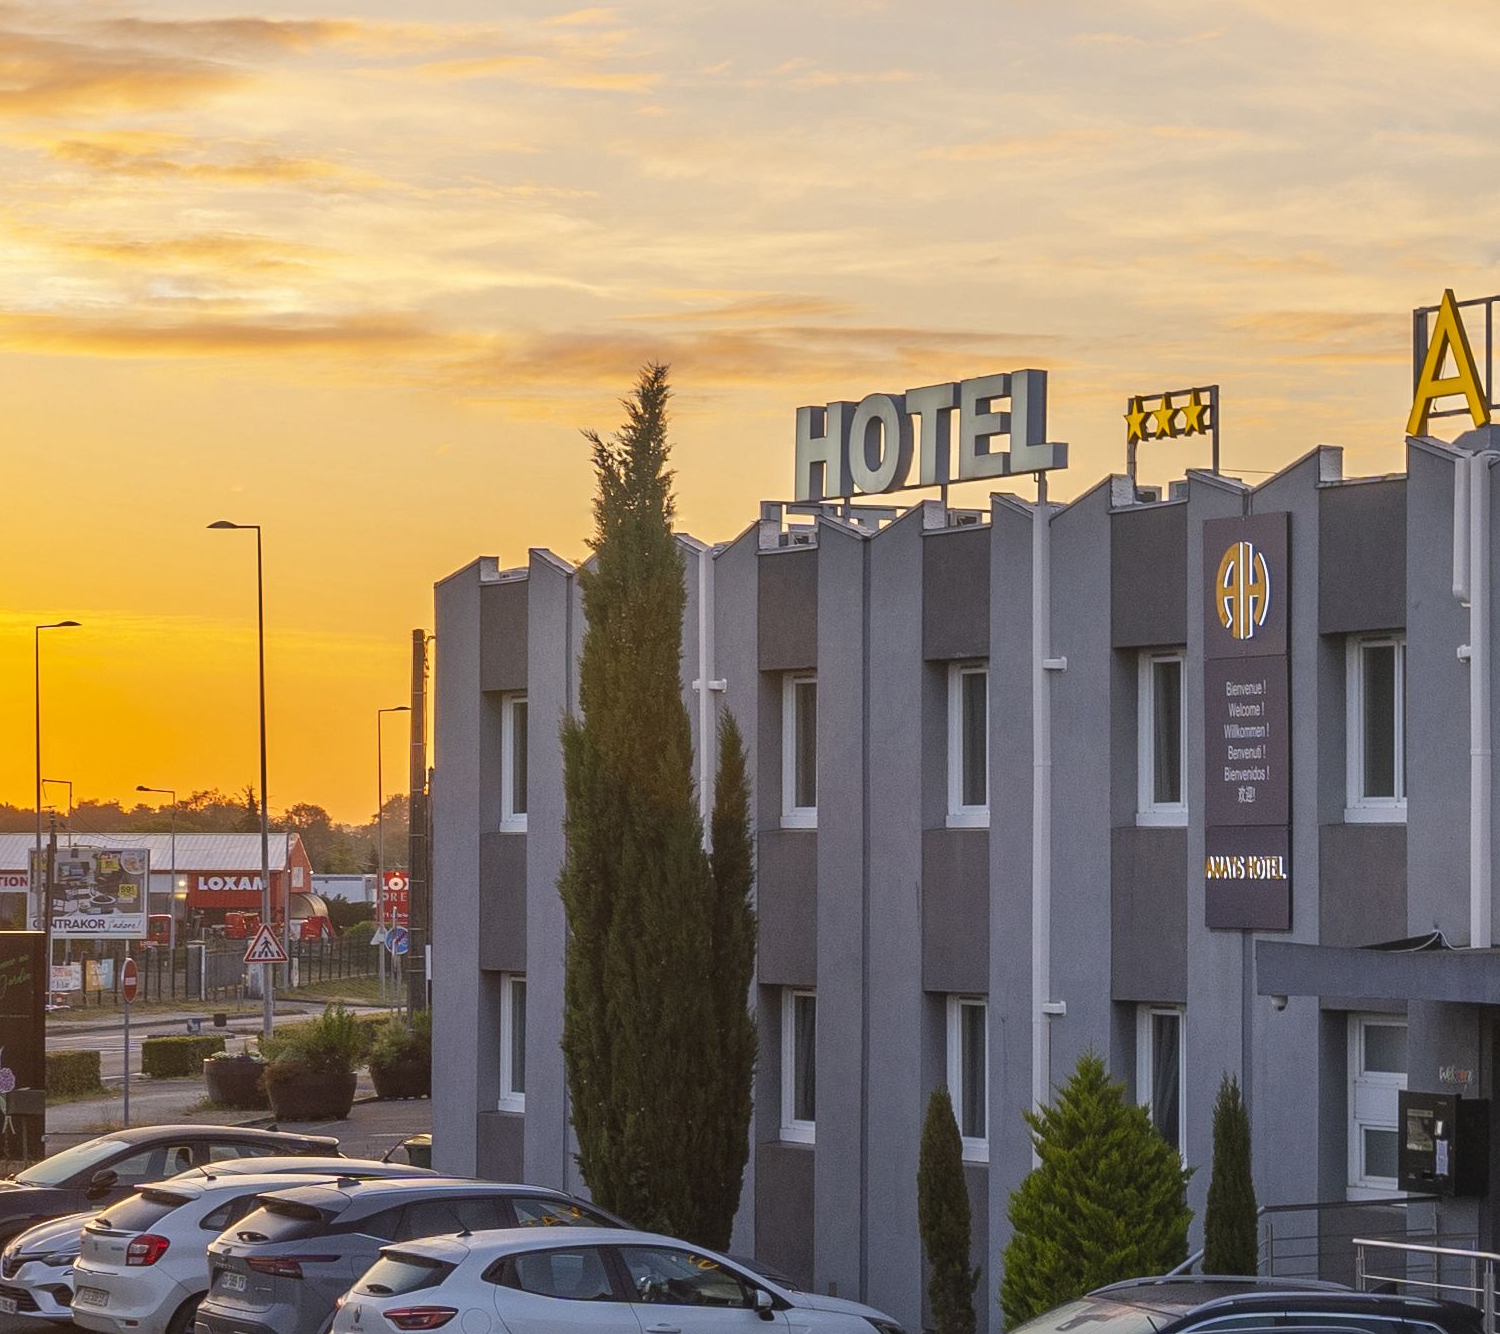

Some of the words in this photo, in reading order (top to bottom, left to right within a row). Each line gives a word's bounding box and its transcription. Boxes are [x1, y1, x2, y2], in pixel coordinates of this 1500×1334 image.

[795, 368, 1068, 501] HOTEL
[1225, 681, 1262, 697] Bienvenue
[1228, 702, 1260, 717] Welcome
[1223, 723, 1265, 739] Willkommen
[1227, 745, 1262, 760] Benvenuti
[1224, 766, 1265, 782] Bienvenidos
[1246, 855, 1287, 880] HOTEL
[33, 919, 105, 929] CNTRAKOR
